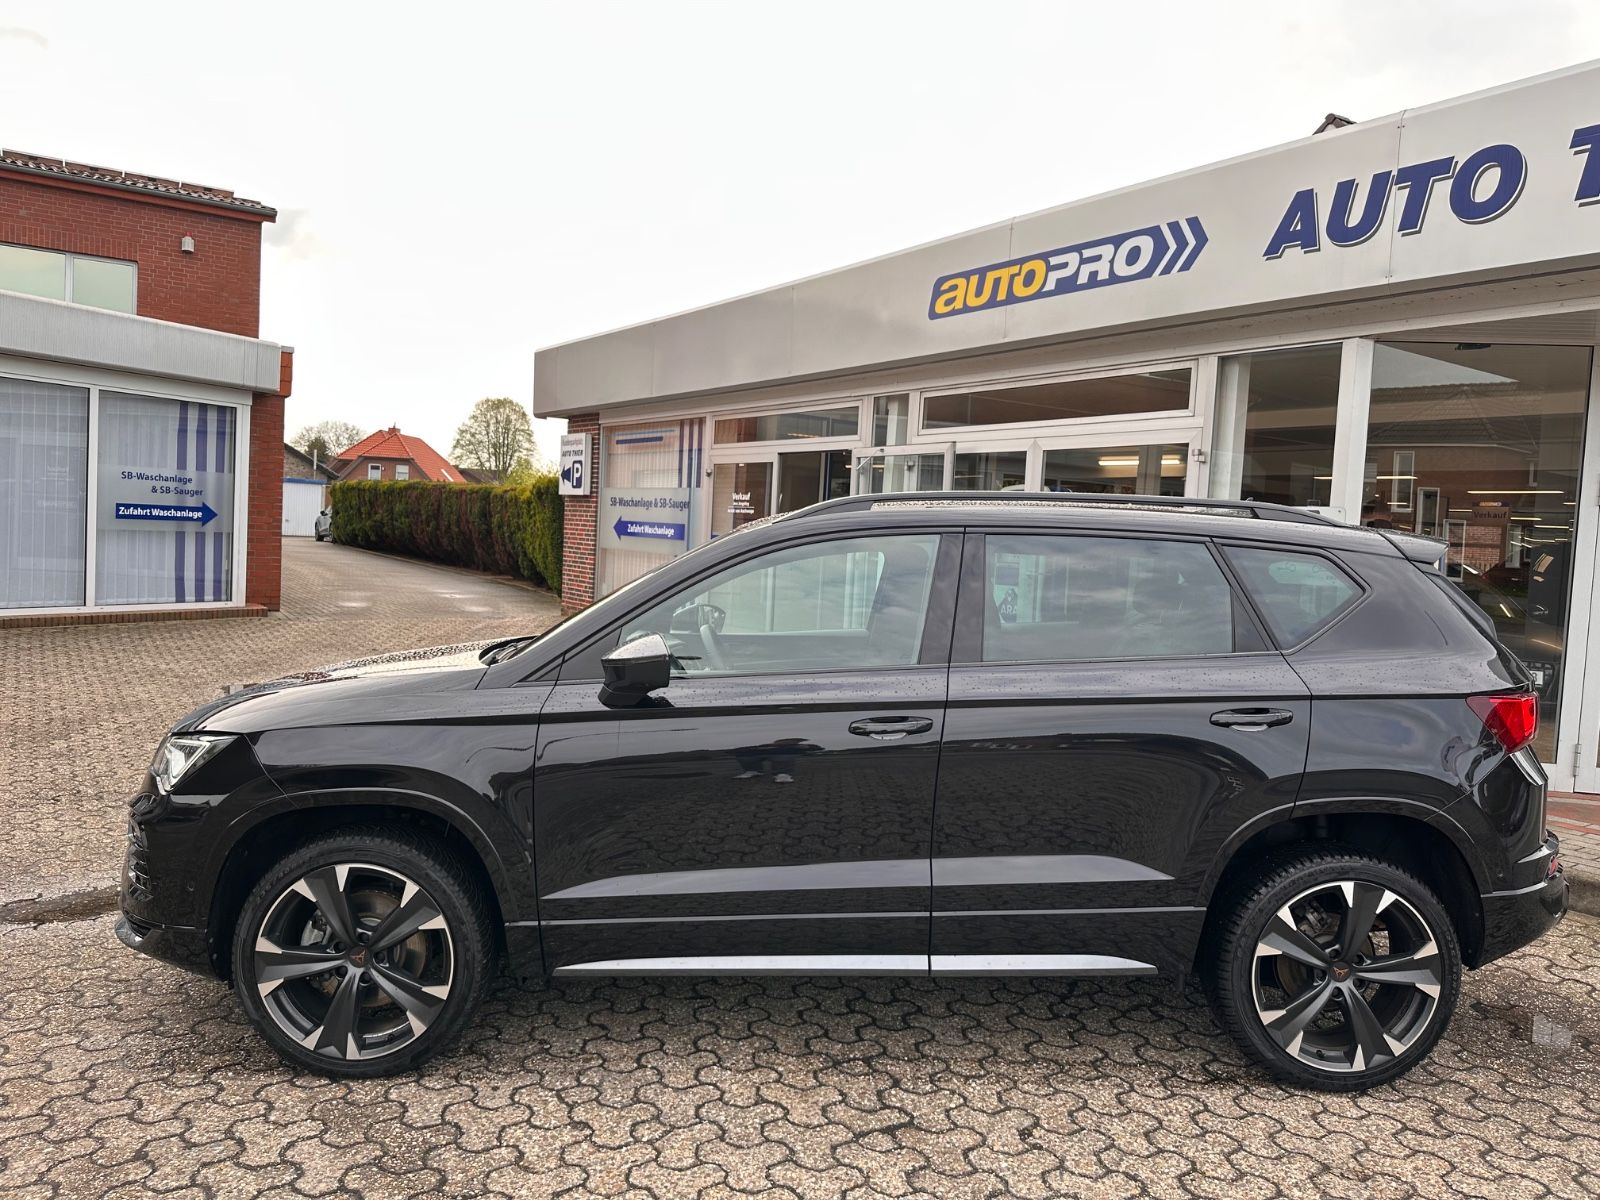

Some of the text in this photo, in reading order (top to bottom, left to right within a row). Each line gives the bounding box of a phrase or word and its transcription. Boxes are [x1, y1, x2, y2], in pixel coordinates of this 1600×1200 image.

[1262, 143, 1528, 261] AUTO
[121, 471, 193, 485] SB-Waschanlage
[151, 485, 204, 497] & SB-Sauger
[610, 496, 691, 512] SB-Waschanlage & SB-Sauger
[118, 506, 203, 519] Zufahrt Waschanlage
[1473, 511, 1508, 519] Verkauf
[627, 523, 675, 538] Zufahrt Waschanlage
